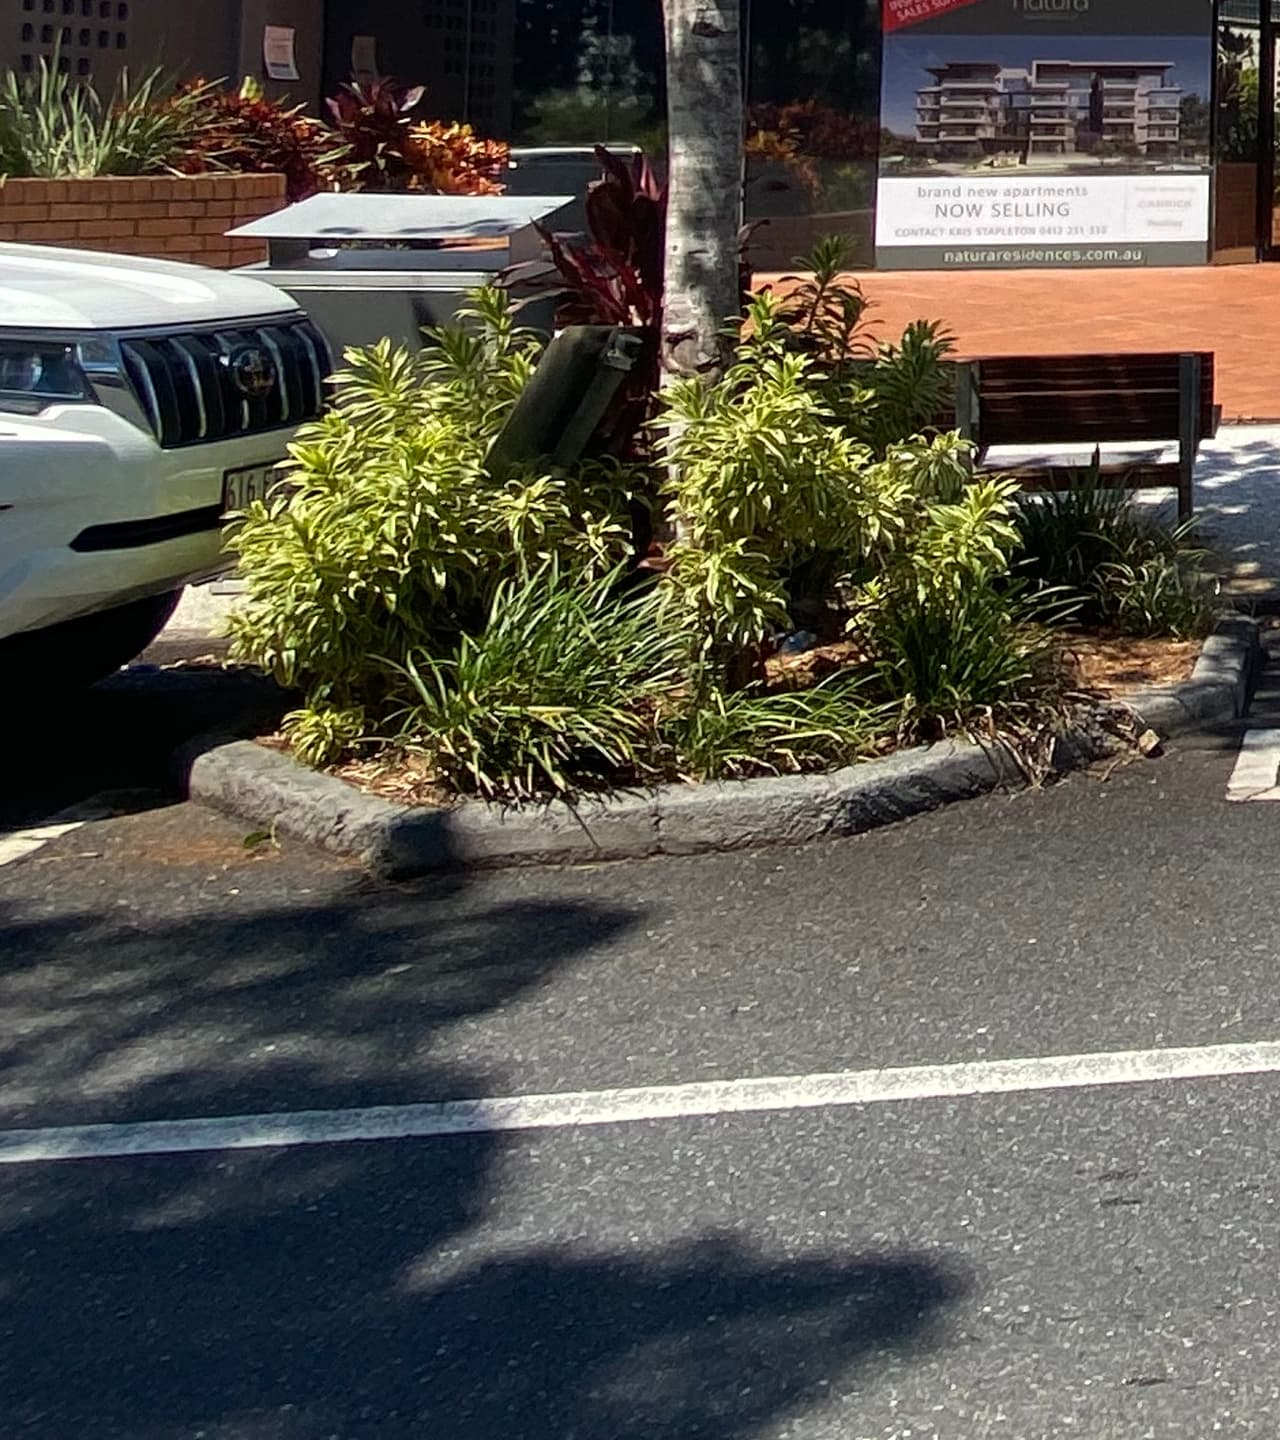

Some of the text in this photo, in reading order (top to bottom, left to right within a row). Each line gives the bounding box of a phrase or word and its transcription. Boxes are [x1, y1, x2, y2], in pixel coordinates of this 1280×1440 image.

[896, 2, 930, 22] SALES
[917, 186, 1089, 199] brand new apartments
[935, 201, 1071, 218] NOW SELLING
[894, 227, 945, 238] CONTACT
[975, 225, 1036, 237] STAPLETON
[943, 248, 1143, 264] naturaresidences.com.au
